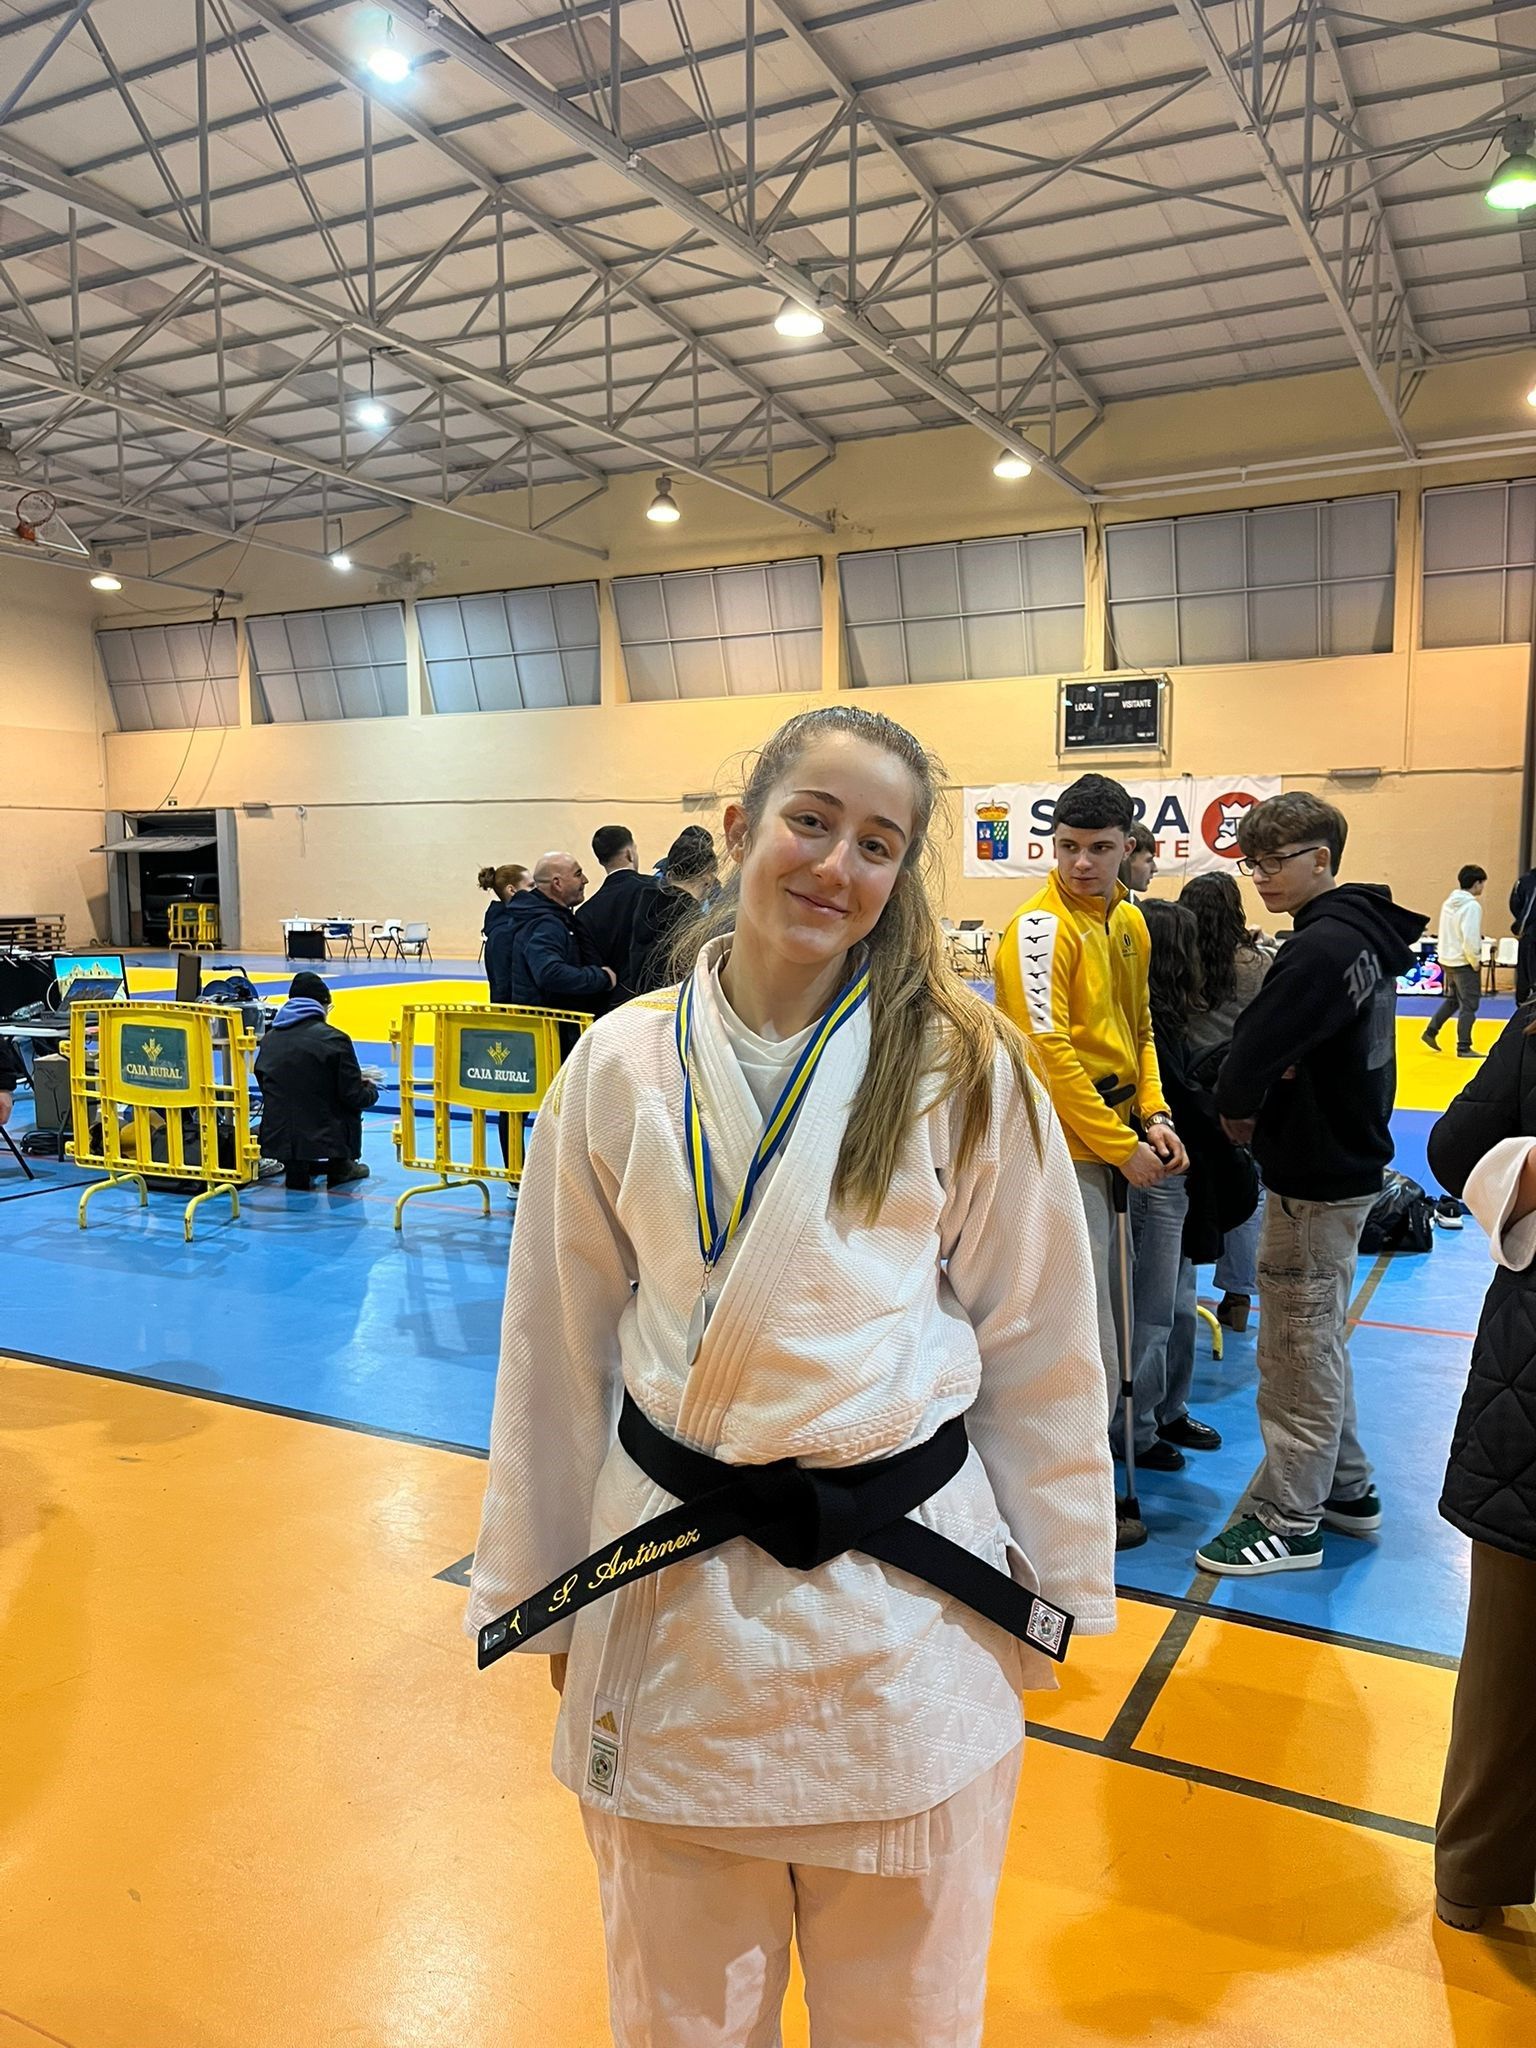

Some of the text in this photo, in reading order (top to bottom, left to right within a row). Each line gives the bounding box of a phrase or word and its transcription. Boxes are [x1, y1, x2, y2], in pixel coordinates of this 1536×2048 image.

[1074, 703, 1094, 712] LOCAL
[1121, 699, 1152, 709] VISITANTE
[149, 1066, 183, 1079] RURAL
[467, 1067, 530, 1083] CAJA RURAL
